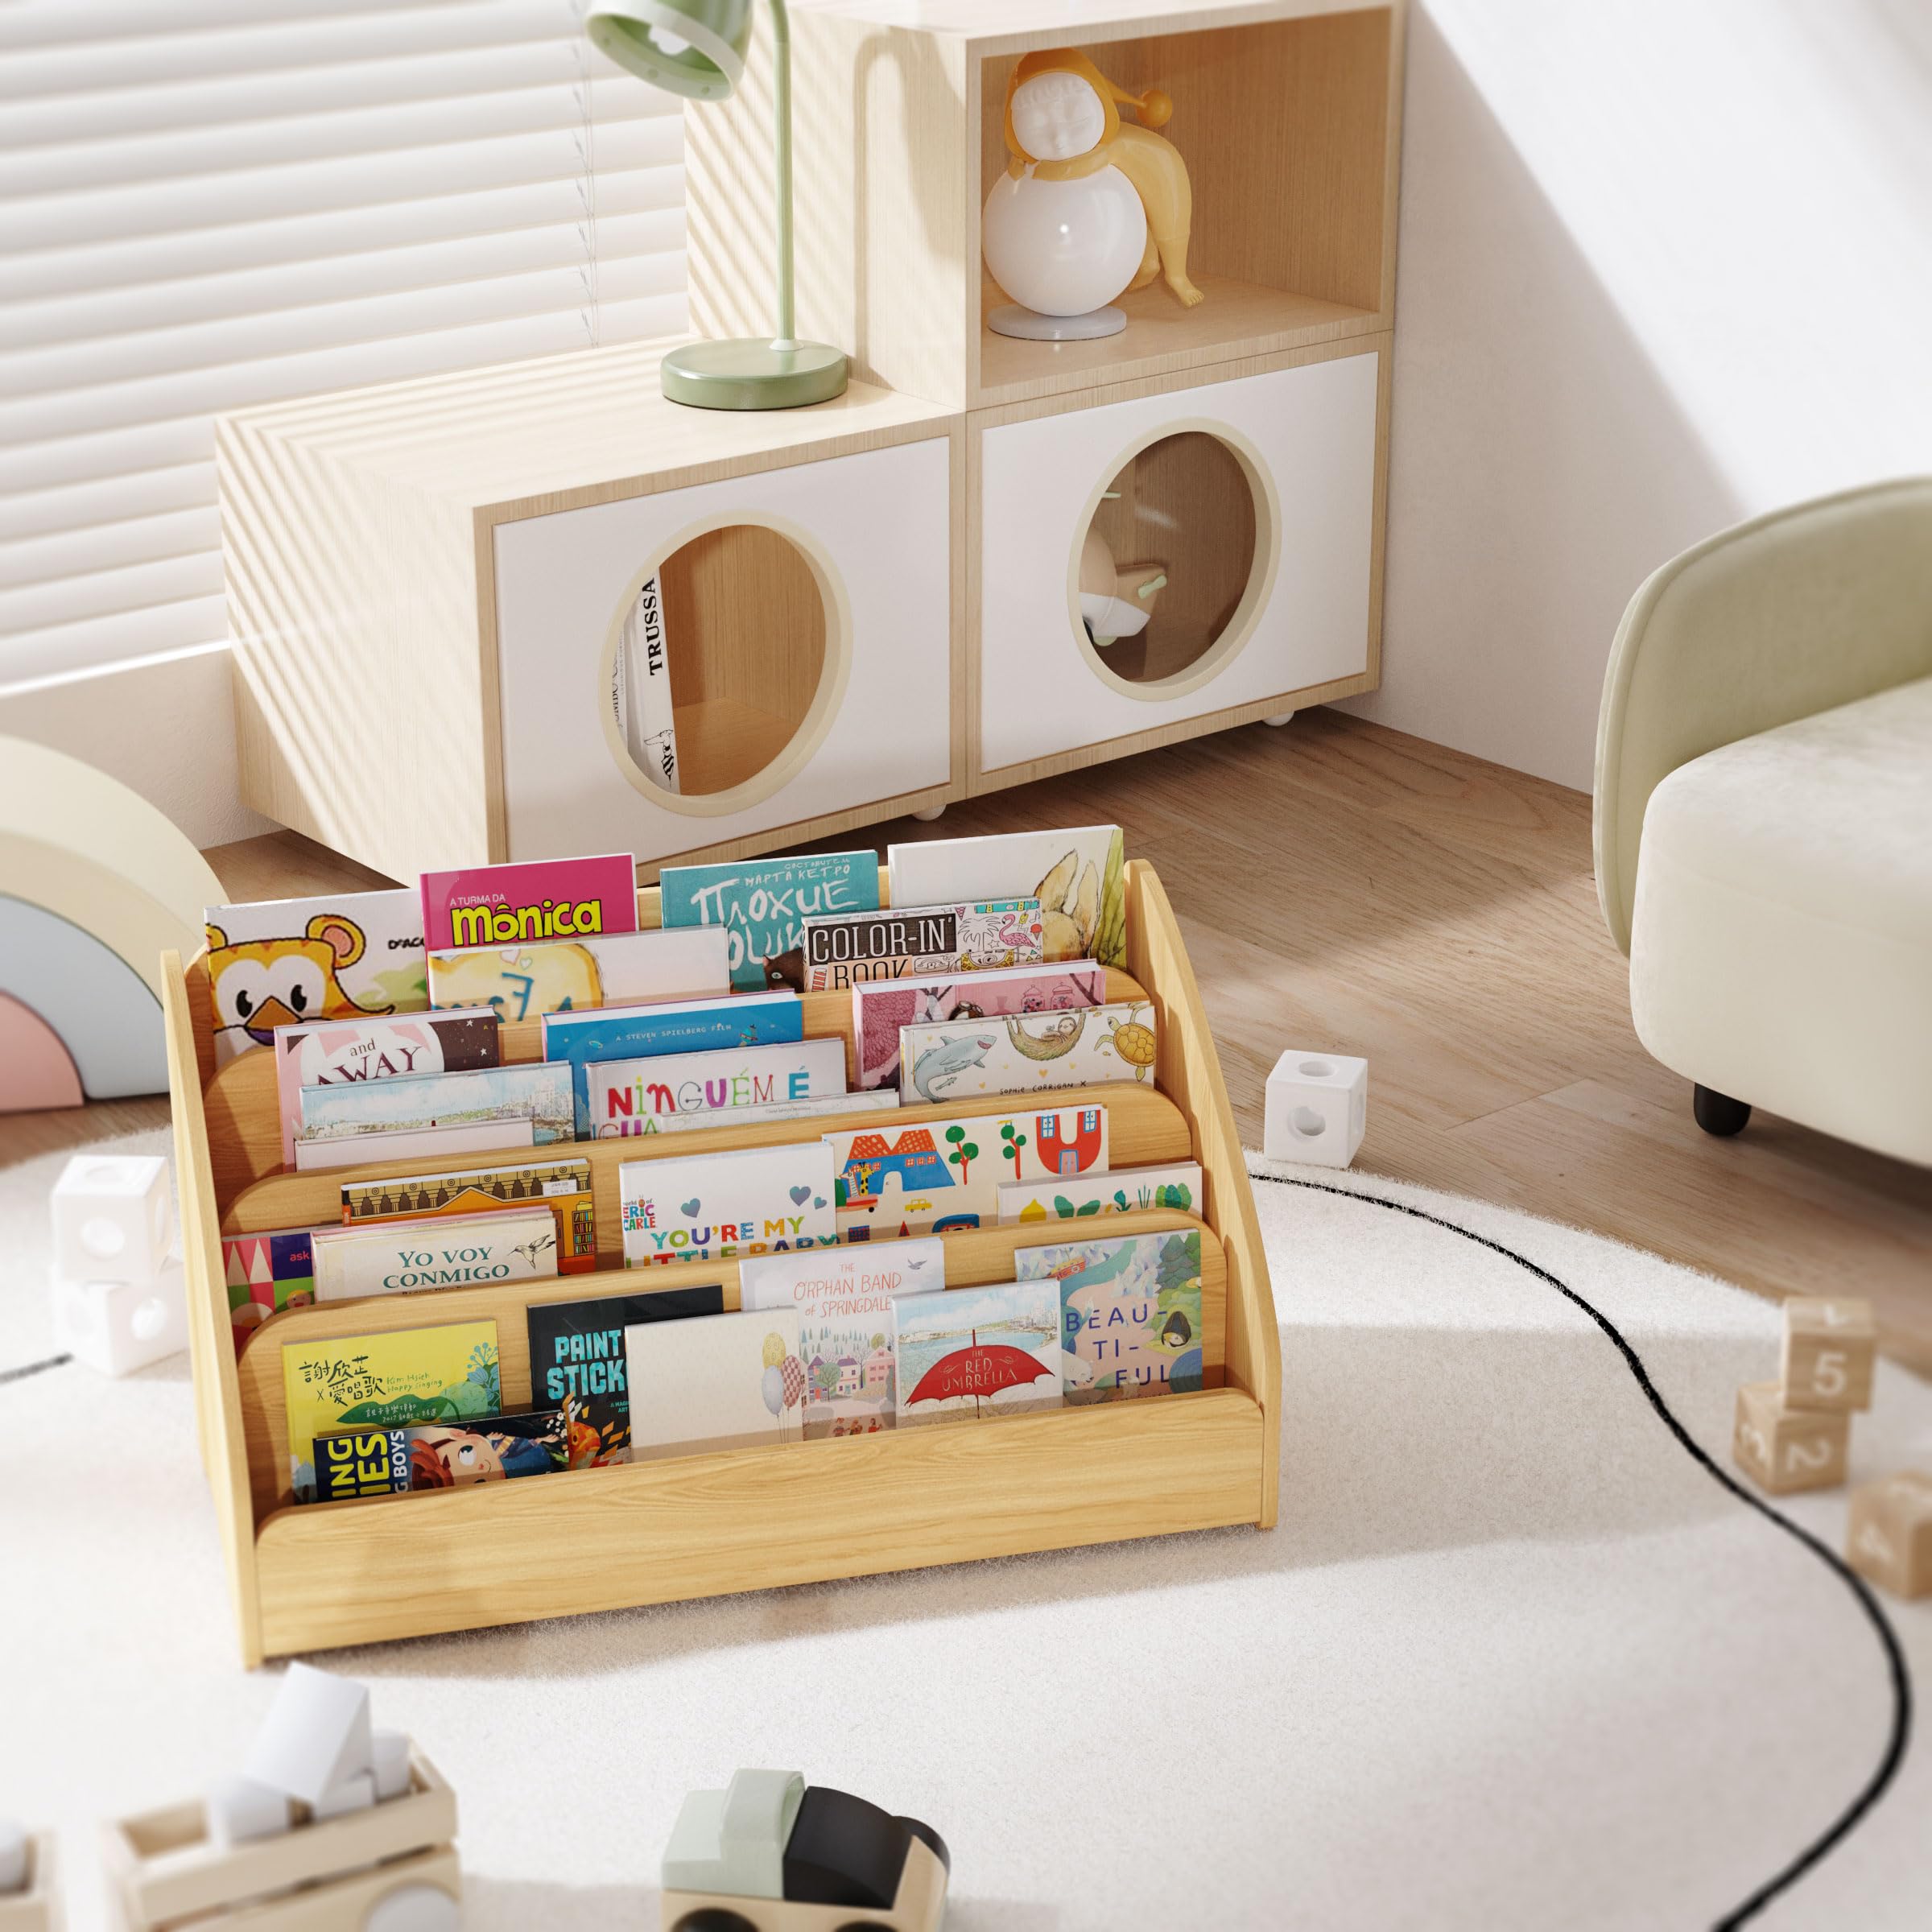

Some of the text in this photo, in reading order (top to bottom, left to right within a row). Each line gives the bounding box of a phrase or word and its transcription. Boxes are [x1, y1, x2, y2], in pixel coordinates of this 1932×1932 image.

[642, 576, 663, 676] TRUSSA
[745, 864, 851, 887] МАРТА КЕТРО
[450, 894, 506, 906] A TURMA DA
[626, 1032, 656, 1041] STEVEN
[662, 1027, 707, 1037] SPIELBERG
[349, 1038, 376, 1057] and
[788, 1066, 810, 1100] É
[623, 1216, 656, 1232] CARLE
[764, 1216, 805, 1237] MY
[442, 1247, 493, 1265] VOY
[382, 1265, 510, 1289] CONMIGO
[839, 1262, 856, 1274] THE
[793, 1272, 902, 1301] ORPHAN BAND
[805, 1295, 892, 1319] of SPRINGDALE
[555, 1330, 621, 1364] PAINT
[972, 1349, 985, 1358] THE
[965, 1358, 993, 1373] RED
[1812, 1351, 1848, 1397] 5
[547, 1359, 628, 1400] STICK
[941, 1368, 1018, 1391] UMBRELLA
[390, 1430, 408, 1478] BOYS
[1785, 1437, 1835, 1474] 2
